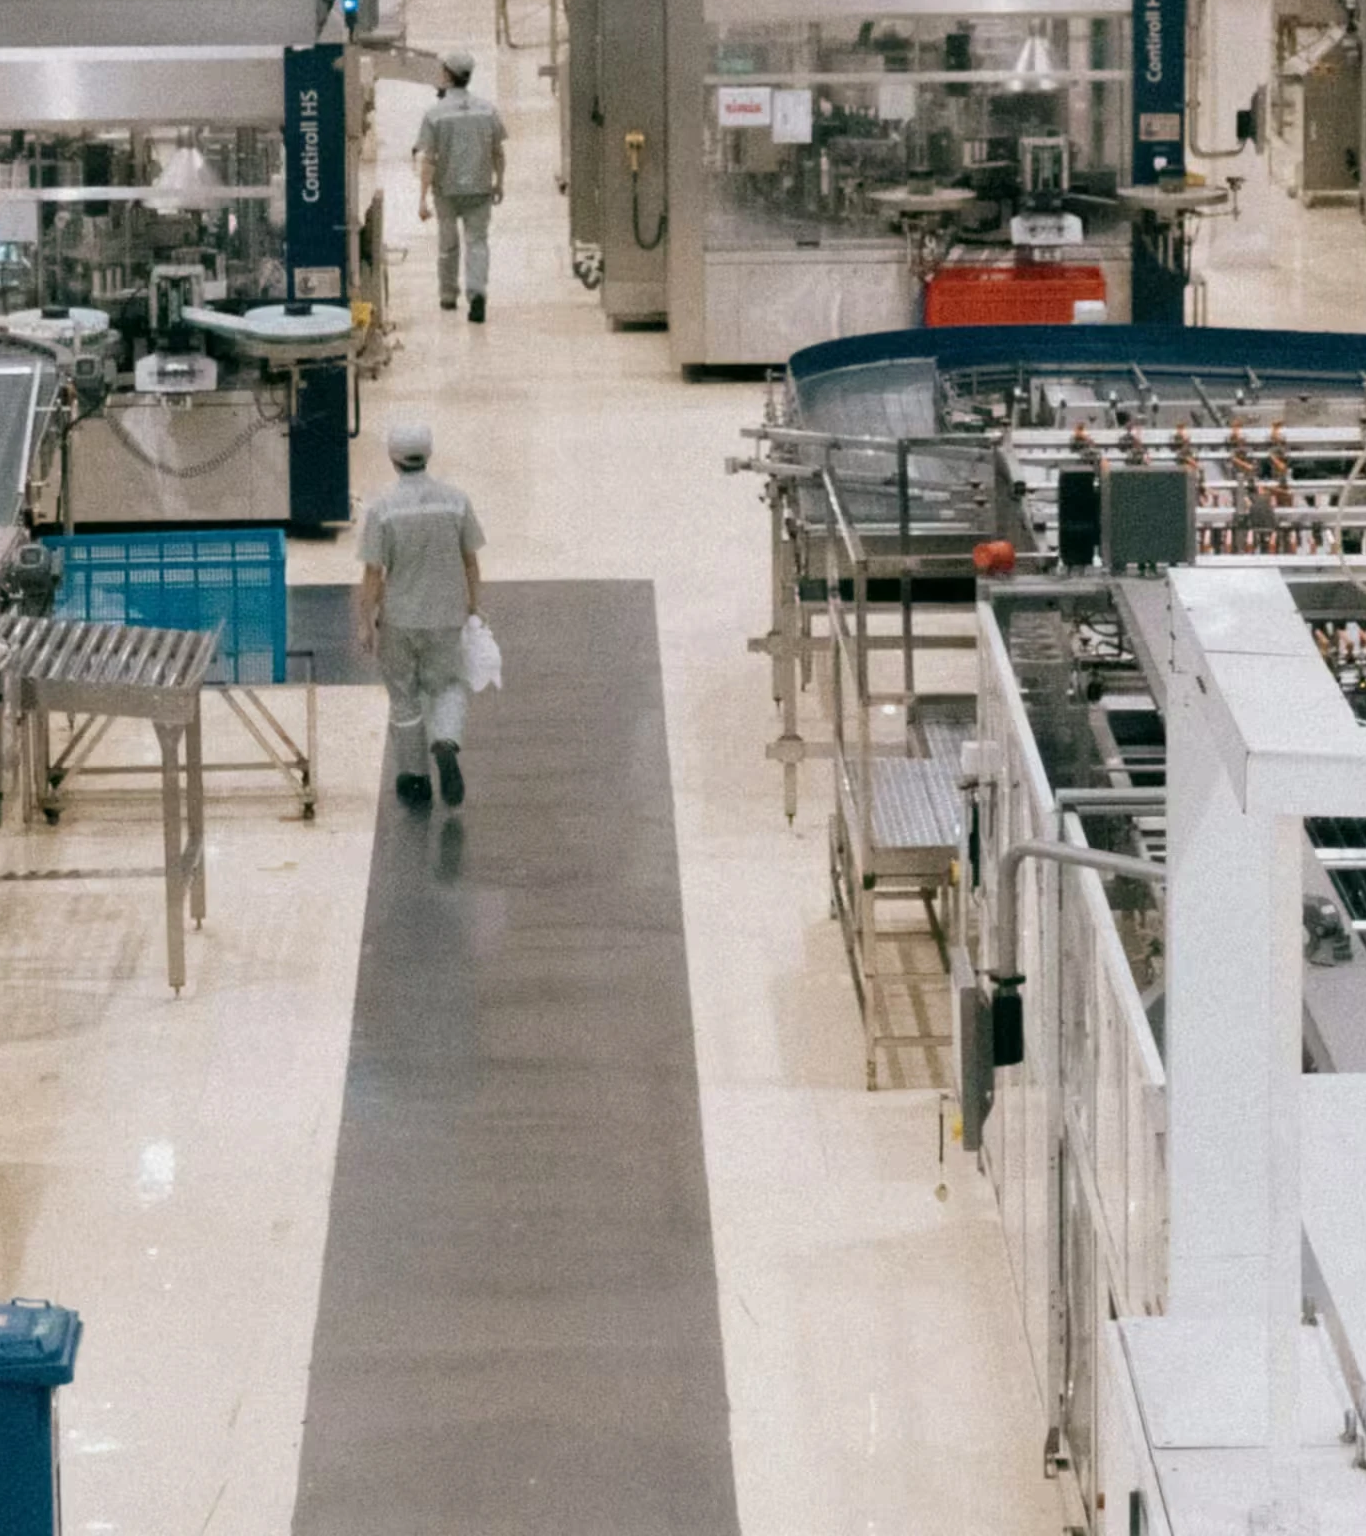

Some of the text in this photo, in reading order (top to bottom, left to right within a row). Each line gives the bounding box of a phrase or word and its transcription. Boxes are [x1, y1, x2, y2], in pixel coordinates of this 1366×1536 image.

[1145, 11, 1162, 82] Contiroll
[300, 89, 320, 203] Contiroll HS
